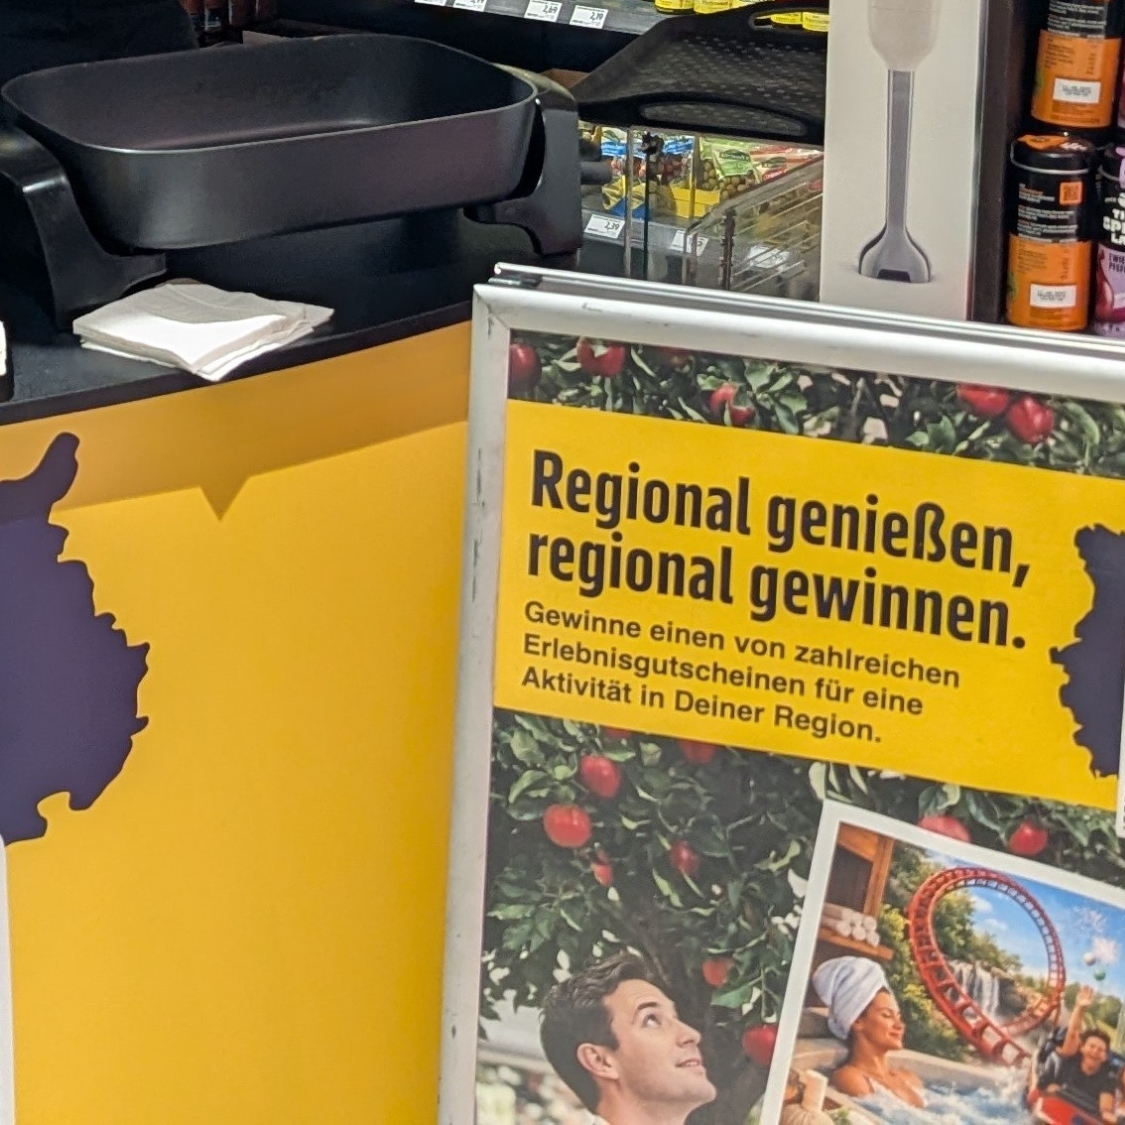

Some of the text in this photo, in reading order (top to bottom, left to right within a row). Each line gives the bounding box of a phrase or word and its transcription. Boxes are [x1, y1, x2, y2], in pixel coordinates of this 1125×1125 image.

[530, 448, 1032, 589] Regional genießen,
[527, 531, 1027, 650] regional gewinnen.
[523, 600, 961, 689] Gewinne einen von zahlreichen
[523, 634, 924, 717] Erlebnisgutscheinen für eine
[521, 666, 883, 745] Aktivität in Deiner Region.
